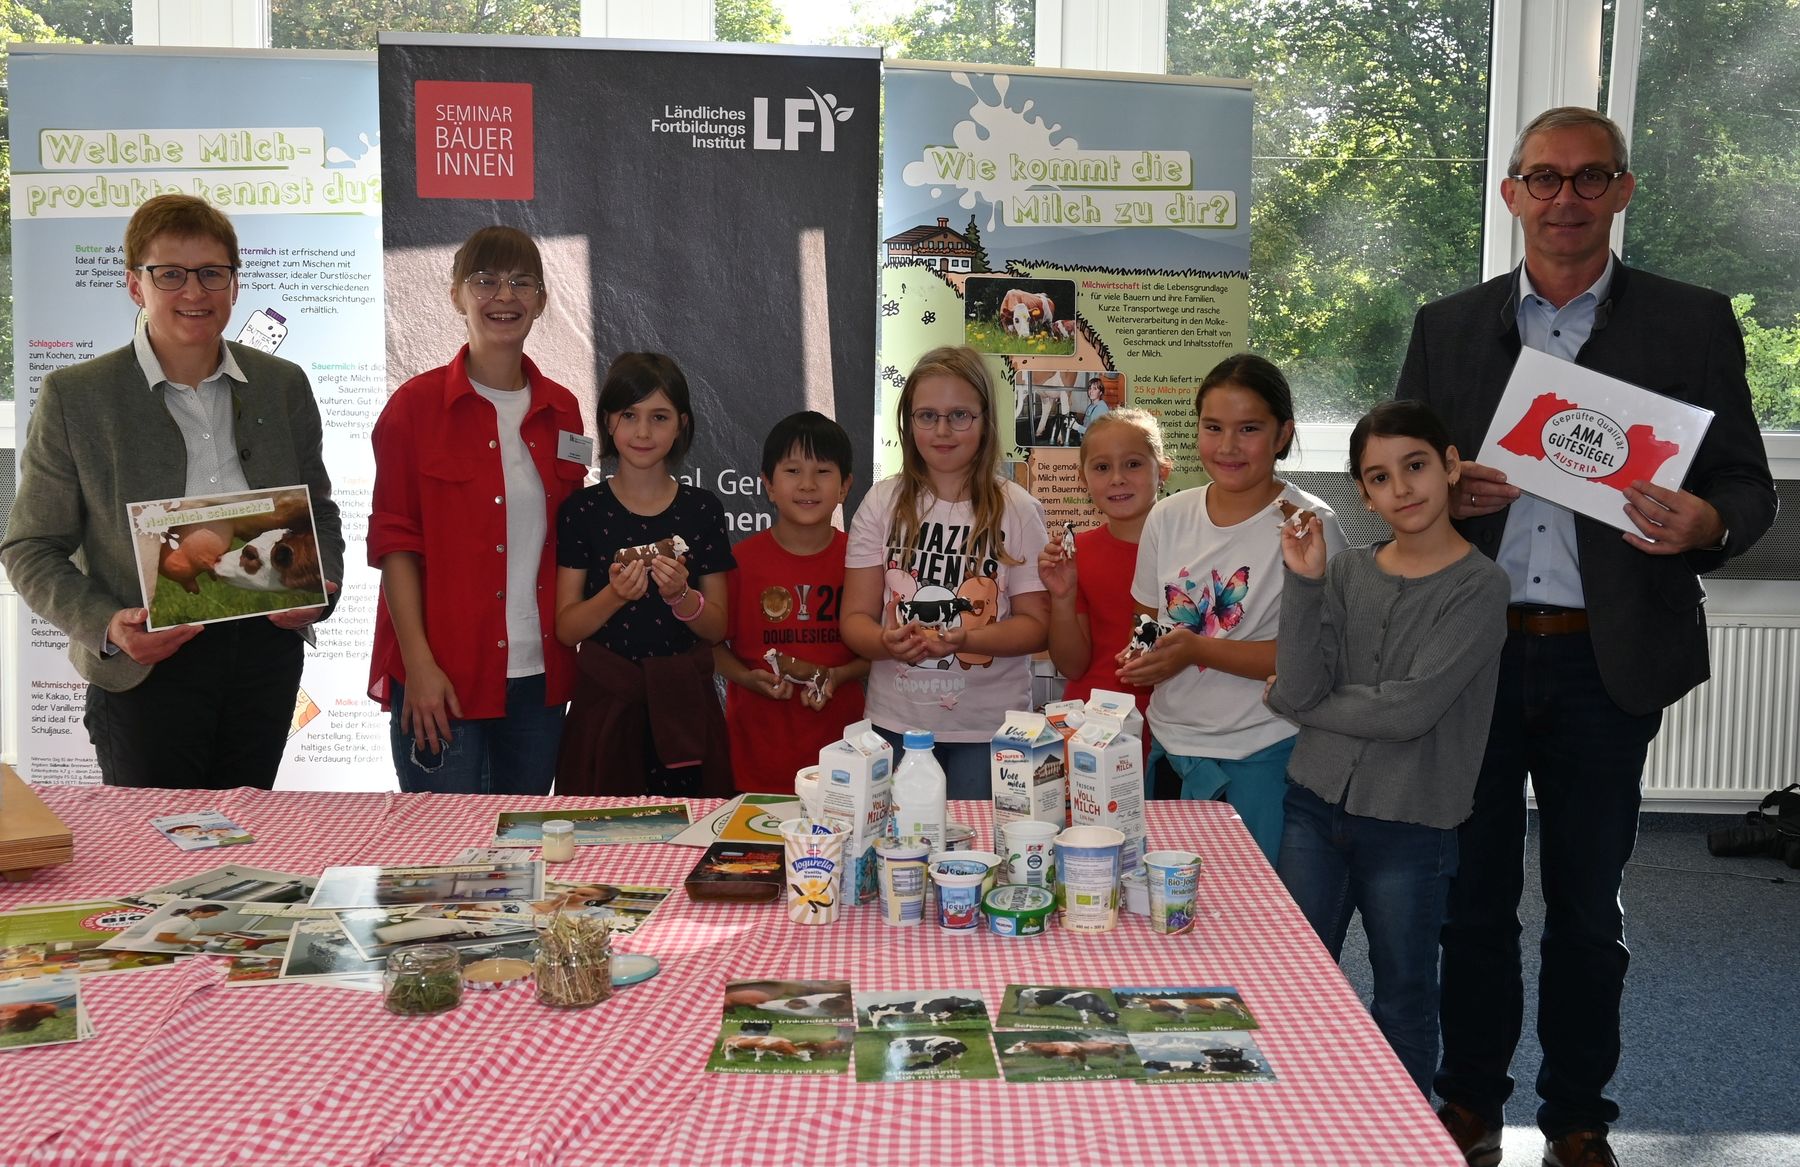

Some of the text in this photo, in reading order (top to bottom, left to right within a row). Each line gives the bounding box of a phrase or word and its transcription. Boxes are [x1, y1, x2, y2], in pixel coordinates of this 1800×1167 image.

[436, 104, 512, 122] SEMINAR
[665, 105, 746, 120] Ländliches
[651, 118, 746, 136] Fortbildungs
[436, 121, 513, 150] BÄUER
[692, 134, 746, 150] Institut
[46, 131, 312, 165] Welche Milch-
[436, 152, 514, 177] INNEN
[931, 151, 1183, 182] Wie kommt die
[193, 176, 314, 207] kennst
[1013, 193, 1230, 224] Milch zu dir?
[75, 245, 102, 253] Butter
[104, 245, 116, 253] als
[240, 247, 356, 257] ttermilch ist erfrischend und
[75, 257, 95, 265] Ideal
[98, 257, 110, 265] für
[245, 259, 280, 269] geeignet
[302, 260, 336, 268] Mischen
[337, 260, 351, 269] mit
[290, 271, 372, 281] idealer Durstlöscher
[75, 279, 87, 288] als
[89, 280, 114, 288] feiner
[251, 282, 370, 292] Sport. Auch in verschiedenen
[1081, 280, 1229, 294] Milchwirtschaft ist die Lebensgrundlage
[281, 293, 376, 305] Geschmacksrichtungen
[1090, 291, 1216, 303] für viele Bauern und ihre Familien.
[300, 306, 339, 314] erhältlich.
[1098, 303, 1221, 315] Kurze Transportwege und rasche
[1107, 315, 1229, 326] Weiterverarbeitung in den Molke-
[1115, 327, 1134, 335] reien
[1136, 328, 1179, 338] garantieren
[1181, 328, 1195, 336] den
[1196, 328, 1218, 337] Erhalt
[28, 340, 94, 349] Schlagobers wird
[1123, 337, 1233, 348] Geschmack und Inhaltsstoffen
[46, 351, 76, 360] Kochen,
[1126, 349, 1163, 358] der Milch.
[29, 362, 54, 371] Binden
[311, 362, 369, 371] Sauermilch ist
[318, 374, 348, 384] gelegte
[350, 374, 372, 382] Milch
[1133, 374, 1193, 383] Jede Kuh liefert
[1134, 386, 1145, 394] 25
[1146, 386, 1156, 396] kg
[1157, 386, 1178, 395] Milch
[1179, 387, 1191, 397] pro
[357, 396, 372, 405] Gut
[1134, 397, 1191, 406] Gemolken wird
[325, 408, 370, 419] Verdauung
[1164, 409, 1187, 417] wobei
[1160, 419, 1182, 428] meist
[1552, 412, 1625, 450] Geprüfte Qualität
[1570, 423, 1604, 448] AMA
[1548, 432, 1615, 468] GÜTESIEGEL
[1037, 462, 1050, 471] Die
[1553, 451, 1597, 474] AUSTRIA
[1037, 473, 1076, 482] Milch wird
[1051, 485, 1088, 493] Bauernho
[1083, 507, 1096, 516] auf
[1075, 519, 1090, 527] und
[348, 604, 366, 613] Brot
[314, 627, 343, 636] Palette
[31, 692, 72, 702] wie Kakao,
[31, 704, 48, 712] oder
[31, 714, 80, 724] sind ideal für
[330, 721, 359, 729] bei der
[31, 726, 73, 738] Schuljause.
[301, 743, 332, 753] haltiges
[294, 755, 352, 766] die Verdauung
[1115, 763, 1133, 772] MILCH
[999, 767, 1019, 780] Voll
[1077, 789, 1096, 804] VOLL
[1073, 797, 1101, 817] MILCH
[795, 859, 833, 872] Jogurella
